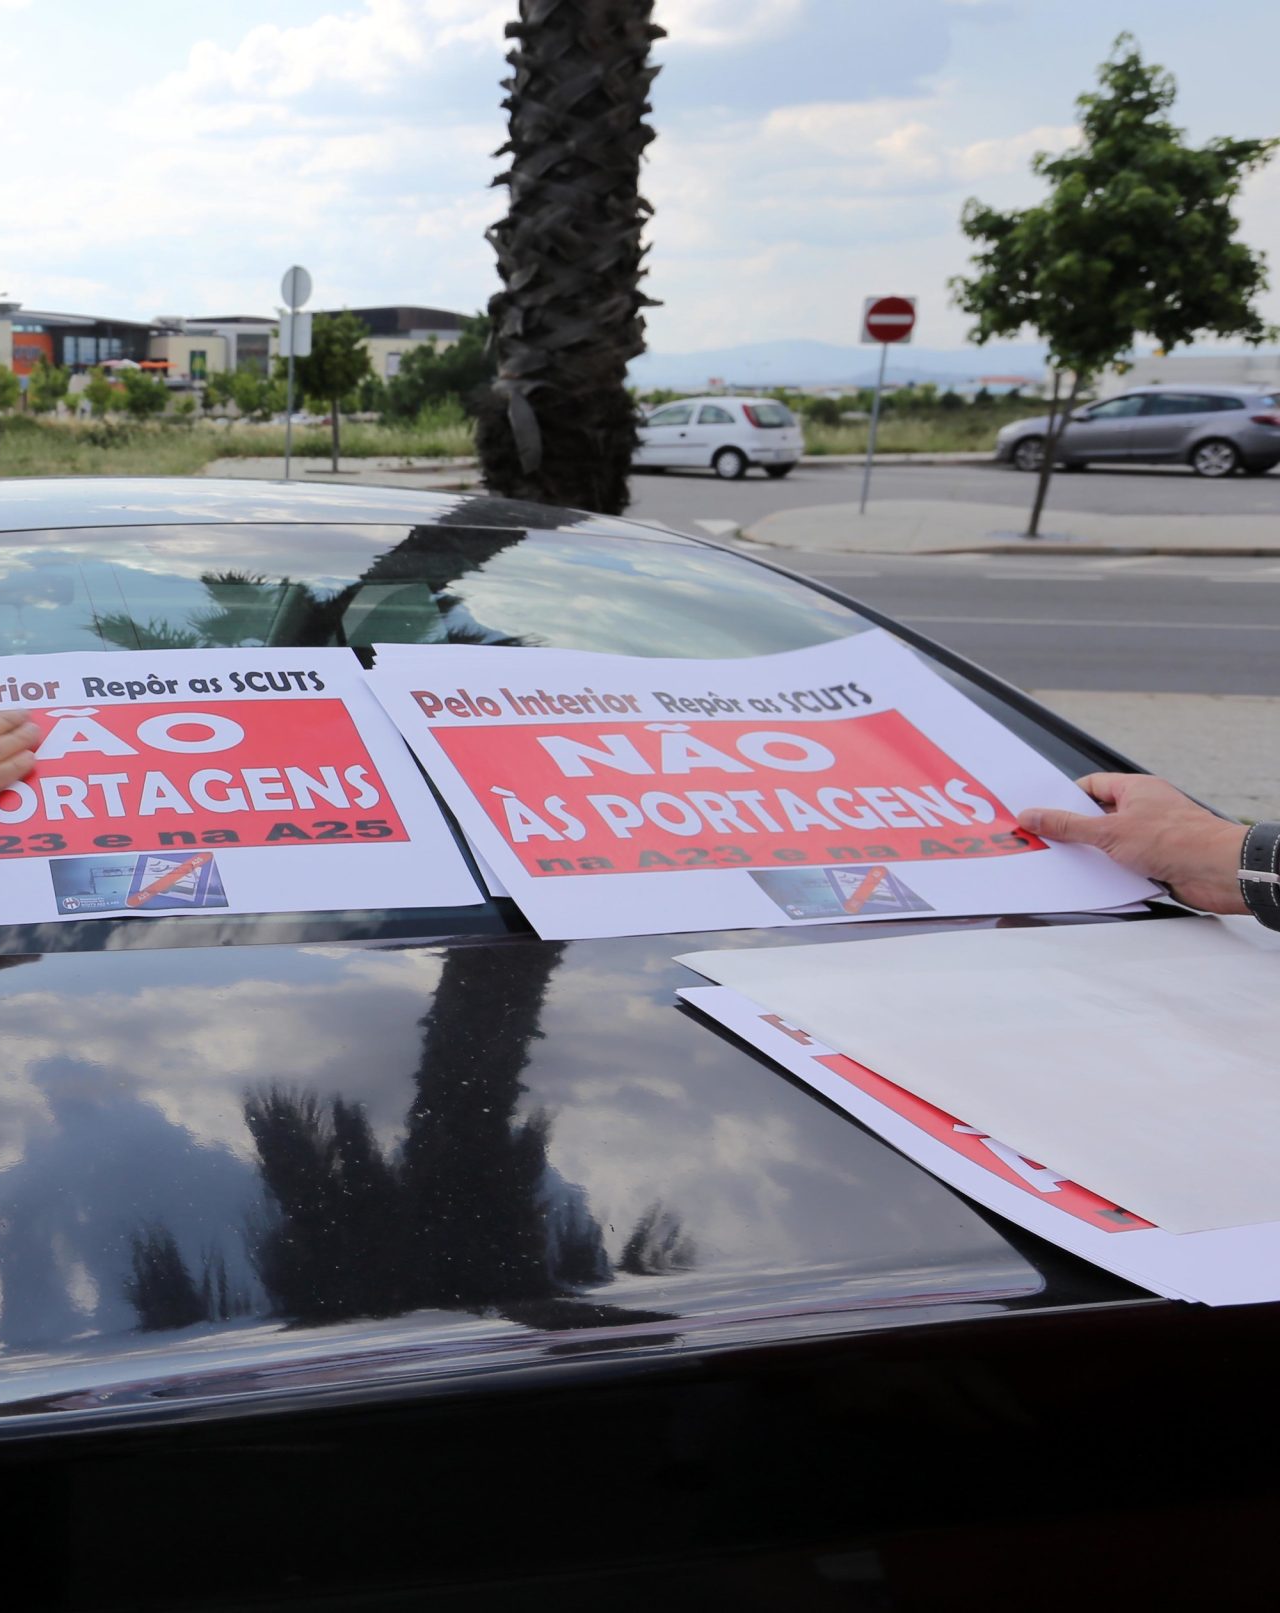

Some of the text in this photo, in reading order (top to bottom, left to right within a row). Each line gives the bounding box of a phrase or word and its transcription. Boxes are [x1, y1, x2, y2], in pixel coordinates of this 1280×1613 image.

[81, 673, 178, 701] Repôr
[188, 675, 223, 694] as
[229, 670, 326, 692] SCUTS
[409, 681, 874, 719] Pelo Interior Repôr as SCUTS
[33, 707, 246, 760] ÃO
[536, 722, 837, 778] NÃO
[489, 777, 996, 844] ÀS PORTAGENS
[92, 833, 134, 849] e
[157, 828, 241, 846] na
[264, 819, 394, 842] A25
[535, 829, 1032, 873] na A23 e na A25
